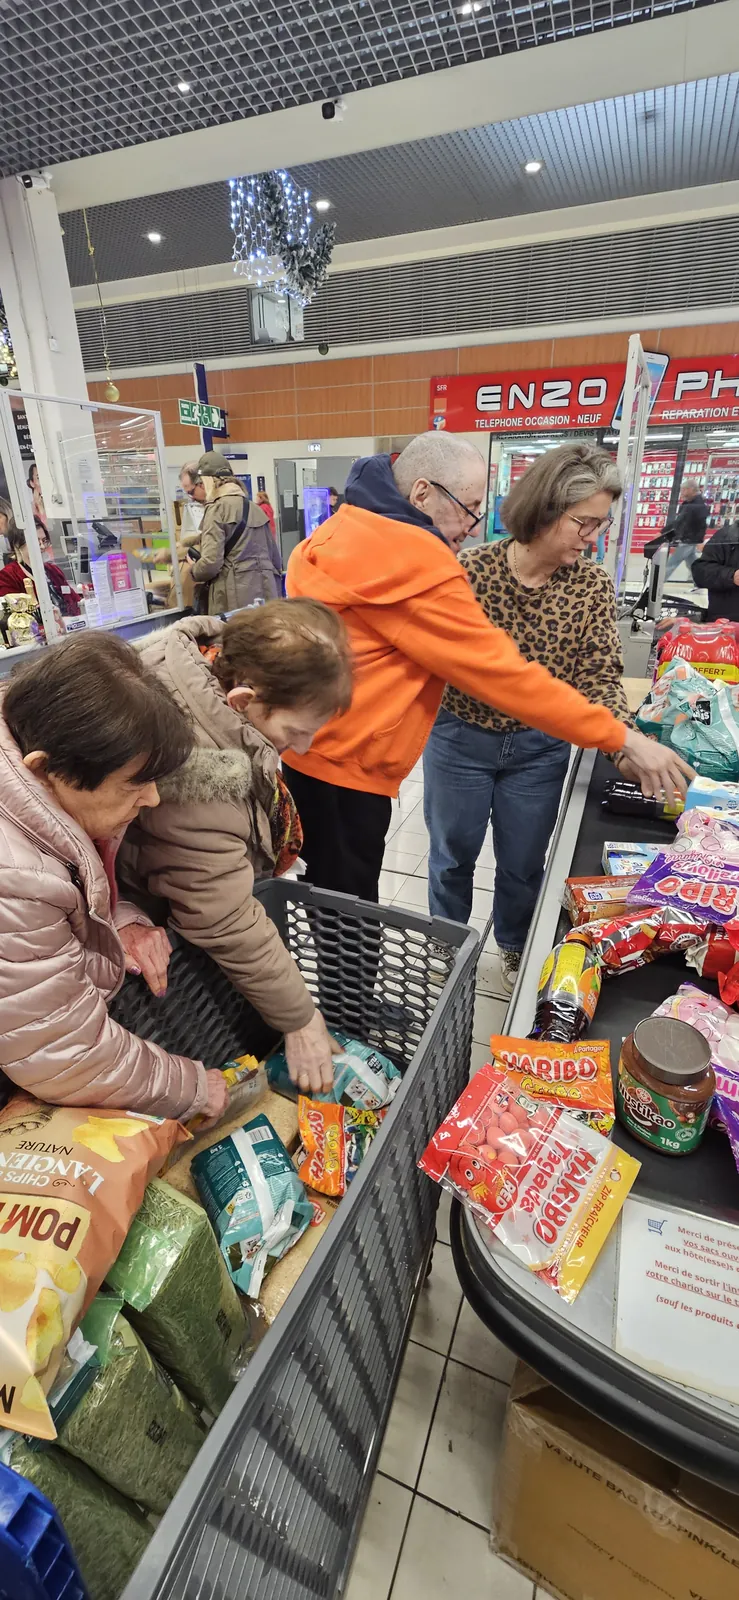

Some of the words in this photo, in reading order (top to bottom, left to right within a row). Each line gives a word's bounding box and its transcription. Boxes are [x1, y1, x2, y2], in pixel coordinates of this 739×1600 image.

[436, 384, 448, 392] SFR
[475, 378, 608, 412] ENZO
[475, 417, 523, 429] TELEPHONE
[524, 414, 570, 426] OCCASION
[577, 413, 602, 424] NEUF
[661, 407, 729, 420] REPARATION
[574, 429, 595, 437] DEVIS
[578, 1045, 604, 1053] Partager
[500, 1051, 598, 1083] HARIBO
[15, 1140, 74, 1156] NATURE
[660, 1136, 680, 1149] 1kg
[4, 1171, 50, 1187] CHIPS
[520, 1141, 573, 1213] Tagada
[496, 1179, 517, 1209] RED
[535, 1147, 598, 1245] HARIBO
[598, 1185, 612, 1201] ZIP
[575, 1199, 605, 1248] FRAÎCHEUR
[677, 1226, 702, 1239] Merci
[704, 1234, 715, 1244] de
[665, 1244, 681, 1254] aux
[683, 1248, 734, 1271] hôte(esse)s
[683, 1239, 699, 1249] vos
[701, 1244, 720, 1256] sacs
[655, 1260, 680, 1274] Merci
[682, 1269, 693, 1278] de
[695, 1274, 721, 1287] sortir
[646, 1269, 669, 1282] votre
[671, 1278, 704, 1295] chariot
[706, 1289, 721, 1301] sur
[723, 1294, 733, 1305] le
[656, 1294, 679, 1309] (sauf
[681, 1302, 693, 1313] les
[695, 1308, 734, 1328] produits
[565, 1455, 603, 1482] JUTE
[606, 1480, 638, 1505] BAG
